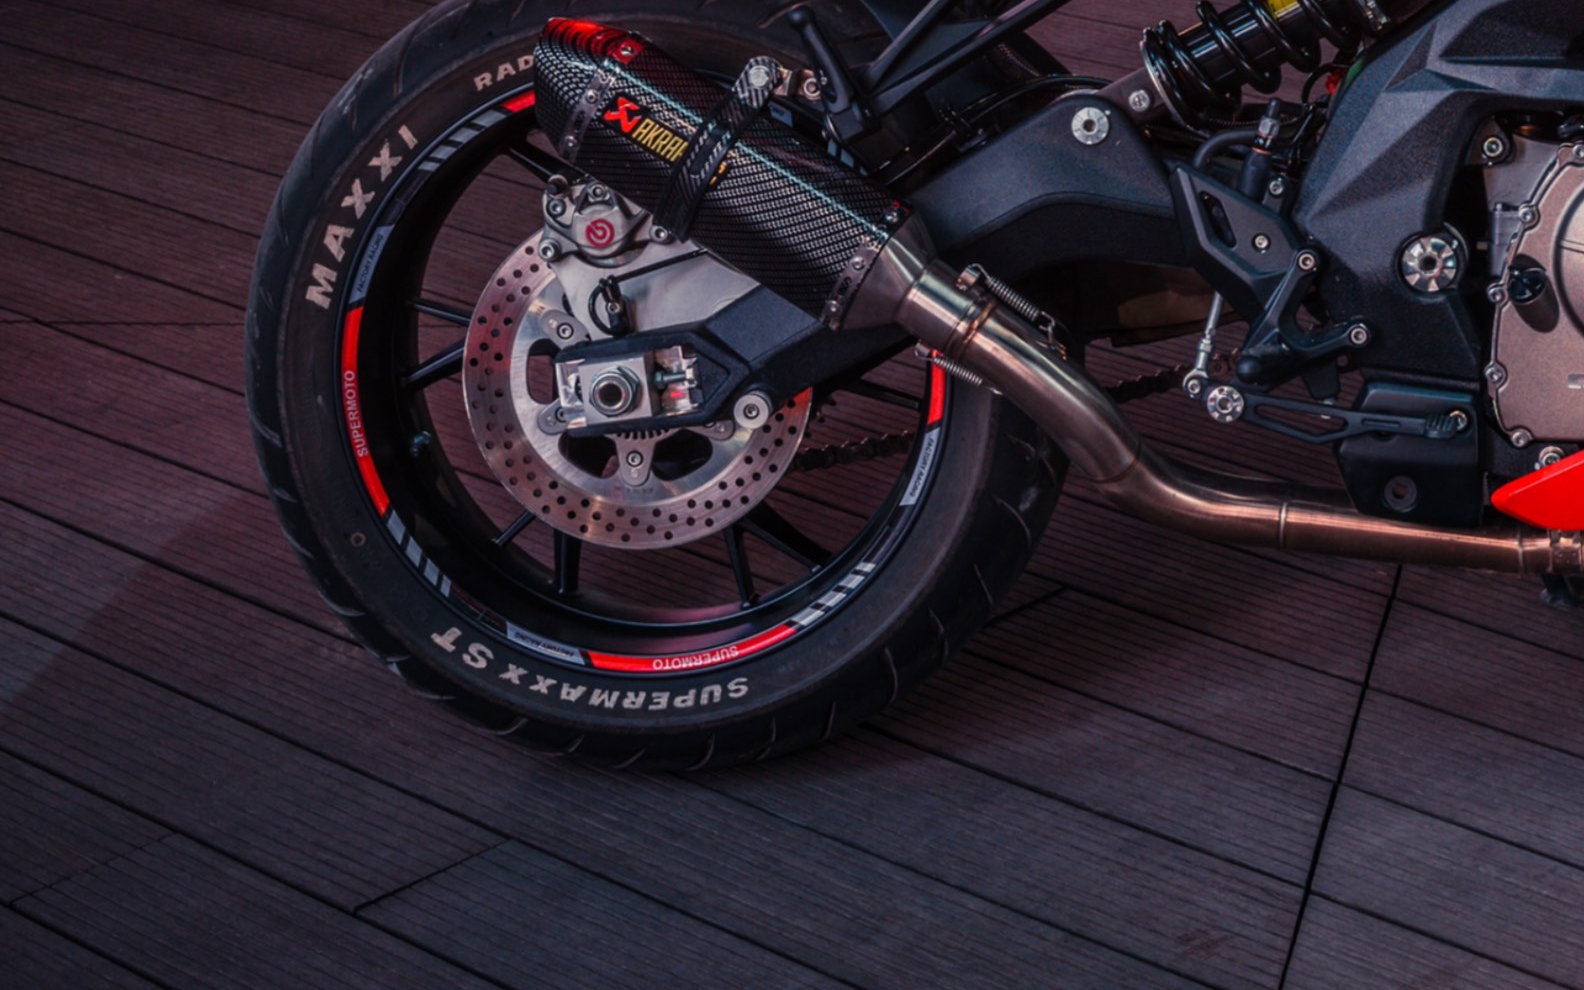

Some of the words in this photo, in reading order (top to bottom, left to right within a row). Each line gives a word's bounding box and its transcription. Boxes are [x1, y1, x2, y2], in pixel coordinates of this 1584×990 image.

[345, 370, 369, 457] SUPERMOTO
[430, 626, 495, 669] ST
[653, 645, 739, 670] SUPERMOTO
[499, 662, 749, 710] SUPERMAXX
